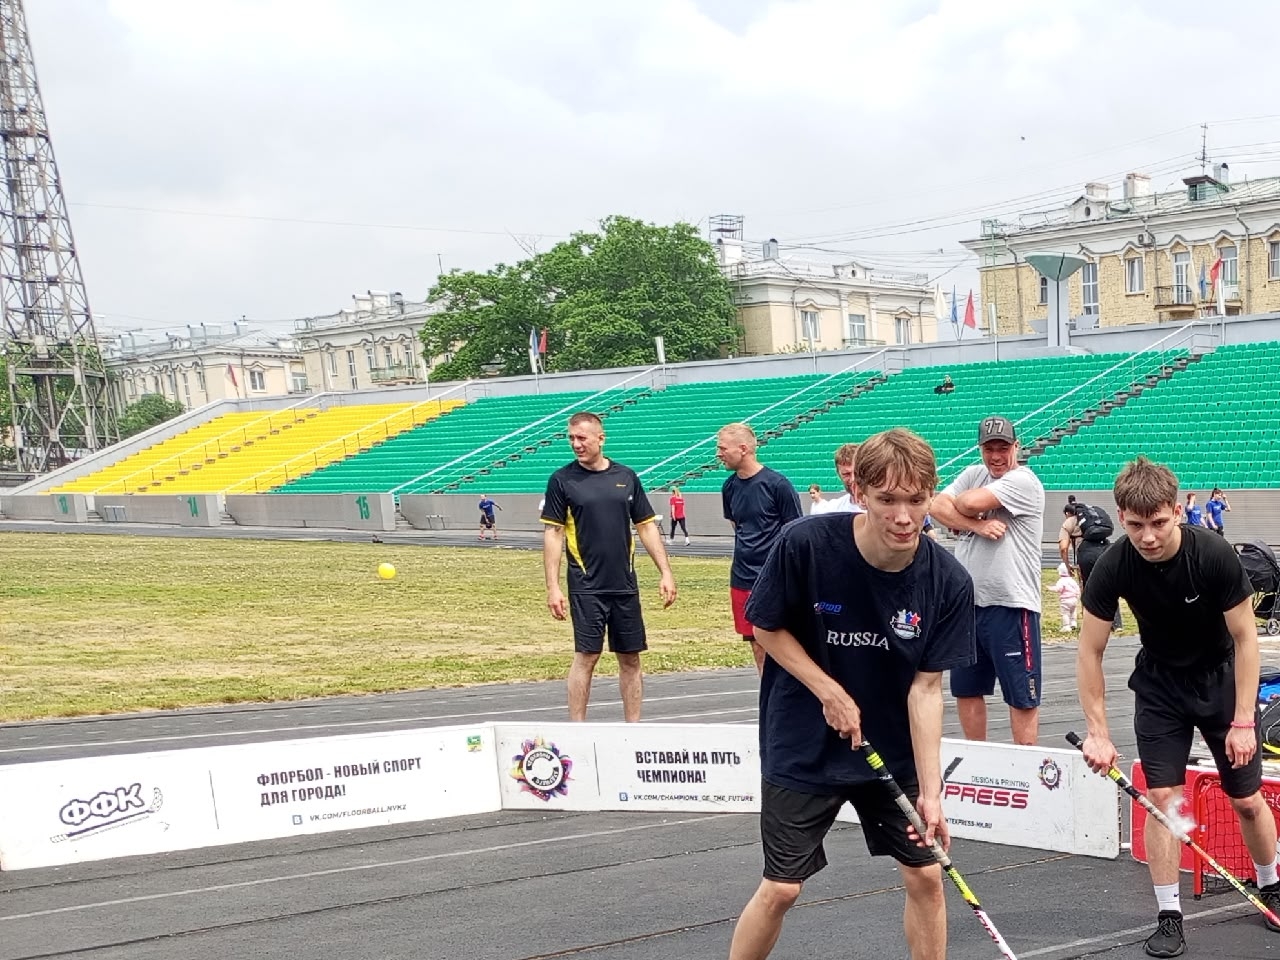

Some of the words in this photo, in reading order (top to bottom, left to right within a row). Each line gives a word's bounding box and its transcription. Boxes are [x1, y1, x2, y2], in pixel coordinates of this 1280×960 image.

[985, 419, 1005, 434] 77
[355, 495, 371, 520] 15
[826, 629, 890, 651] RUSSIA
[635, 749, 689, 765] ВСТАВАЙ
[693, 751, 709, 765] НА
[711, 751, 741, 766] ПУТЬ
[256, 767, 324, 787] ФЛОРБОЛ
[333, 759, 380, 779] НОВЫЙ
[383, 757, 422, 774] СПОРТ
[637, 769, 707, 784] ЧЕМПИОНА!
[971, 775, 995, 785] DESIGN
[1001, 778, 1030, 789] PRINTING
[59, 783, 145, 826] ФФК
[260, 789, 289, 807] ДЛЯ
[291, 784, 347, 803] ГОРОДА!
